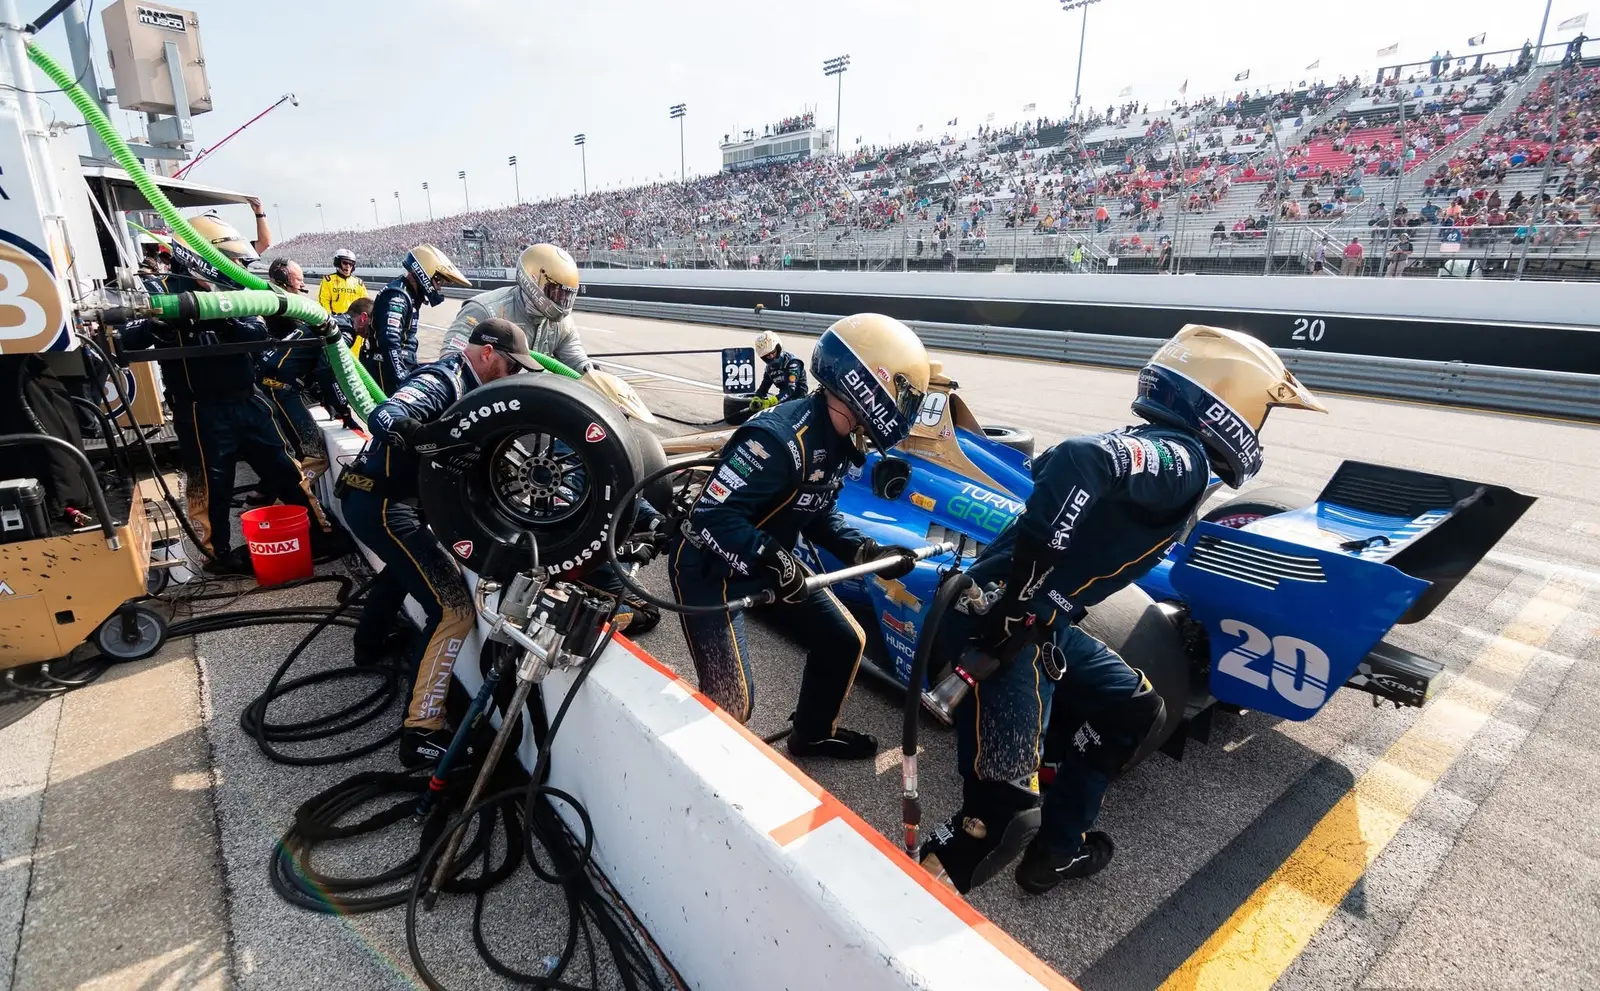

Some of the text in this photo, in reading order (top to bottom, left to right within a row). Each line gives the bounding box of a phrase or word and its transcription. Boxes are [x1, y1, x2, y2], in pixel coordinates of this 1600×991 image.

[175, 246, 219, 275] BITNILE
[412, 261, 435, 293] BITNILE
[518, 270, 545, 306] BITNILE
[781, 294, 790, 307] 19
[1292, 318, 1325, 341] 20
[725, 363, 754, 386] 20
[879, 368, 890, 382] BELL
[844, 369, 898, 433] BITNILE
[378, 409, 394, 431] BITN
[870, 416, 890, 437] .COM
[1205, 402, 1260, 463] BITNILE
[718, 470, 740, 490] SUPPLY
[947, 495, 1018, 533] GRE
[250, 540, 297, 554] SONAX
[701, 528, 749, 572] BITNILE
[776, 550, 794, 579] sparco
[1048, 589, 1074, 613] sparco
[886, 633, 915, 660] HURC
[1217, 618, 1331, 709] 20
[425, 638, 462, 719] BITNILE
[1380, 677, 1425, 698] XTRAC
[416, 746, 440, 757] sparco
